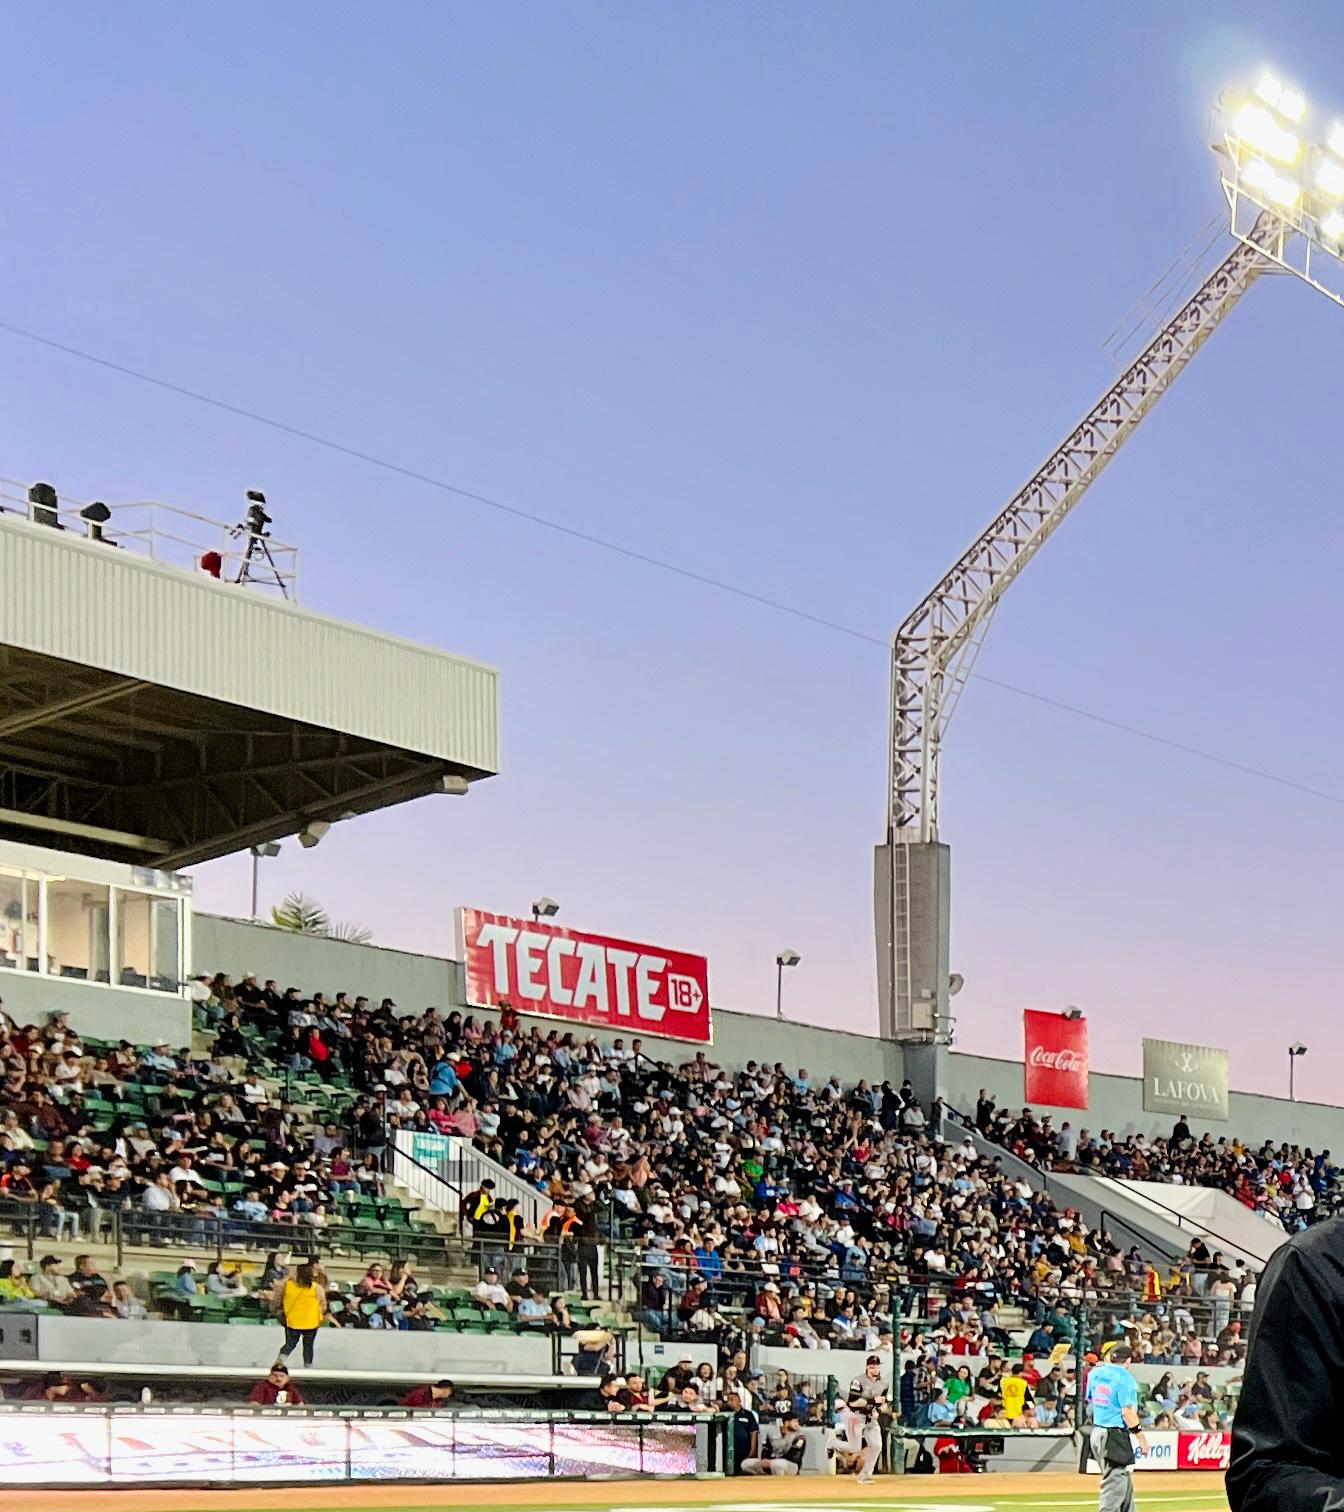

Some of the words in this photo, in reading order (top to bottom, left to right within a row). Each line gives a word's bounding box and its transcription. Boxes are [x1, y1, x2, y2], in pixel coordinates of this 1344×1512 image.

[476, 922, 667, 1022] TECATE
[671, 978, 702, 1007] 18+
[1153, 1077, 1221, 1105] LAFOVA
